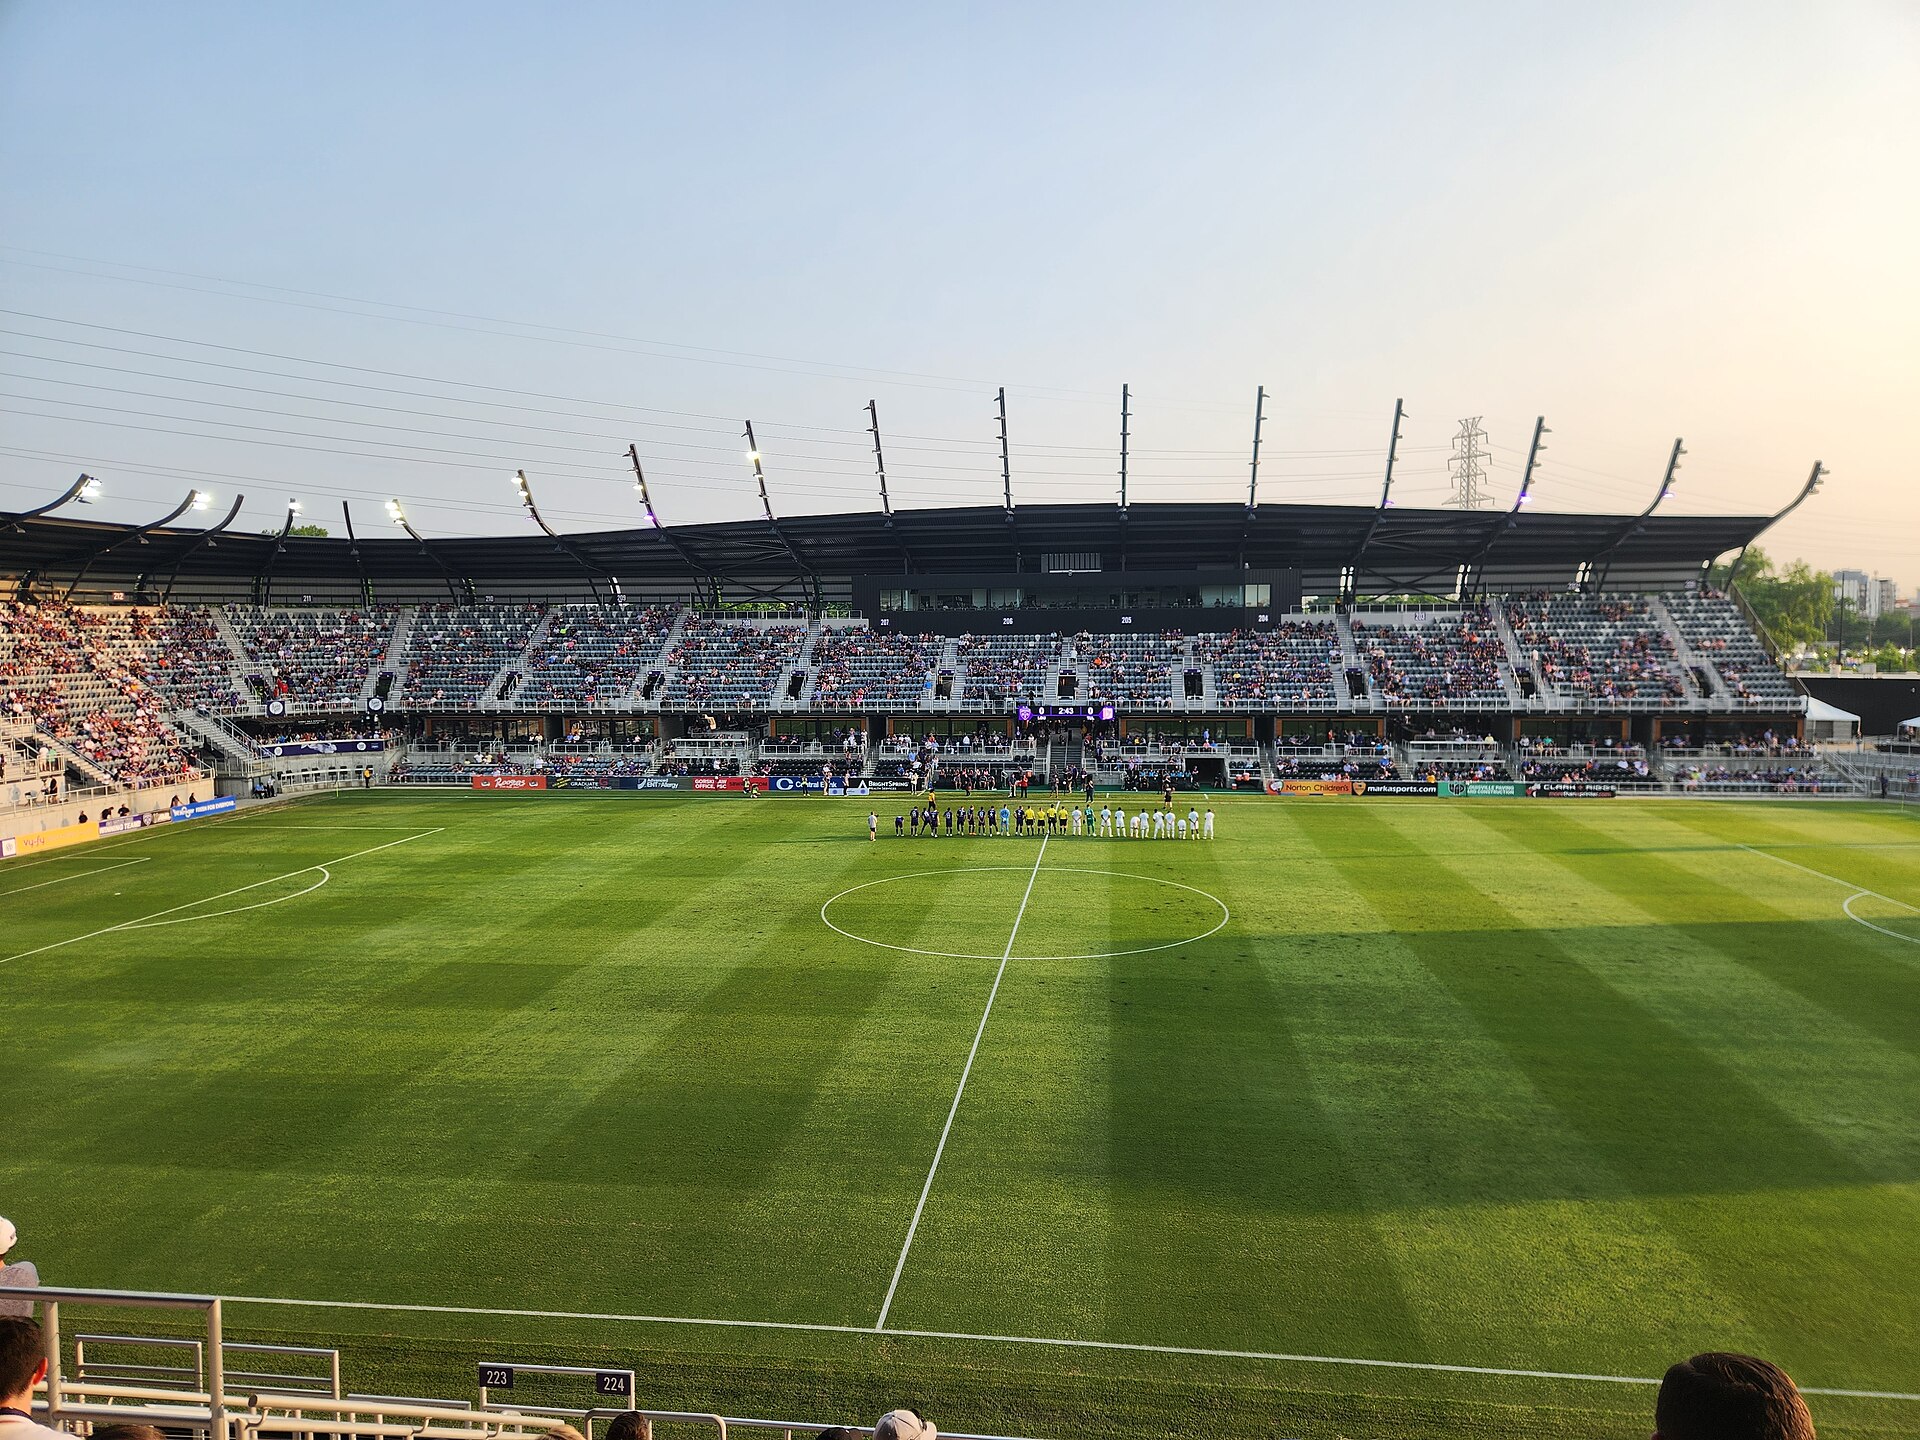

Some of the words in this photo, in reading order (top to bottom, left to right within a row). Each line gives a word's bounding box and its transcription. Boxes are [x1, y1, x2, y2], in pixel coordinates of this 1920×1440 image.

[880, 618, 890, 626] 207
[1038, 706, 1045, 715] 0
[1058, 706, 1074, 715] 2:43
[1087, 706, 1094, 715] 0
[1286, 784, 1313, 792] Norton
[1313, 783, 1349, 792] Children's
[1367, 785, 1437, 794] markasports.com
[486, 1370, 507, 1385] 223
[603, 1376, 625, 1392] 224
